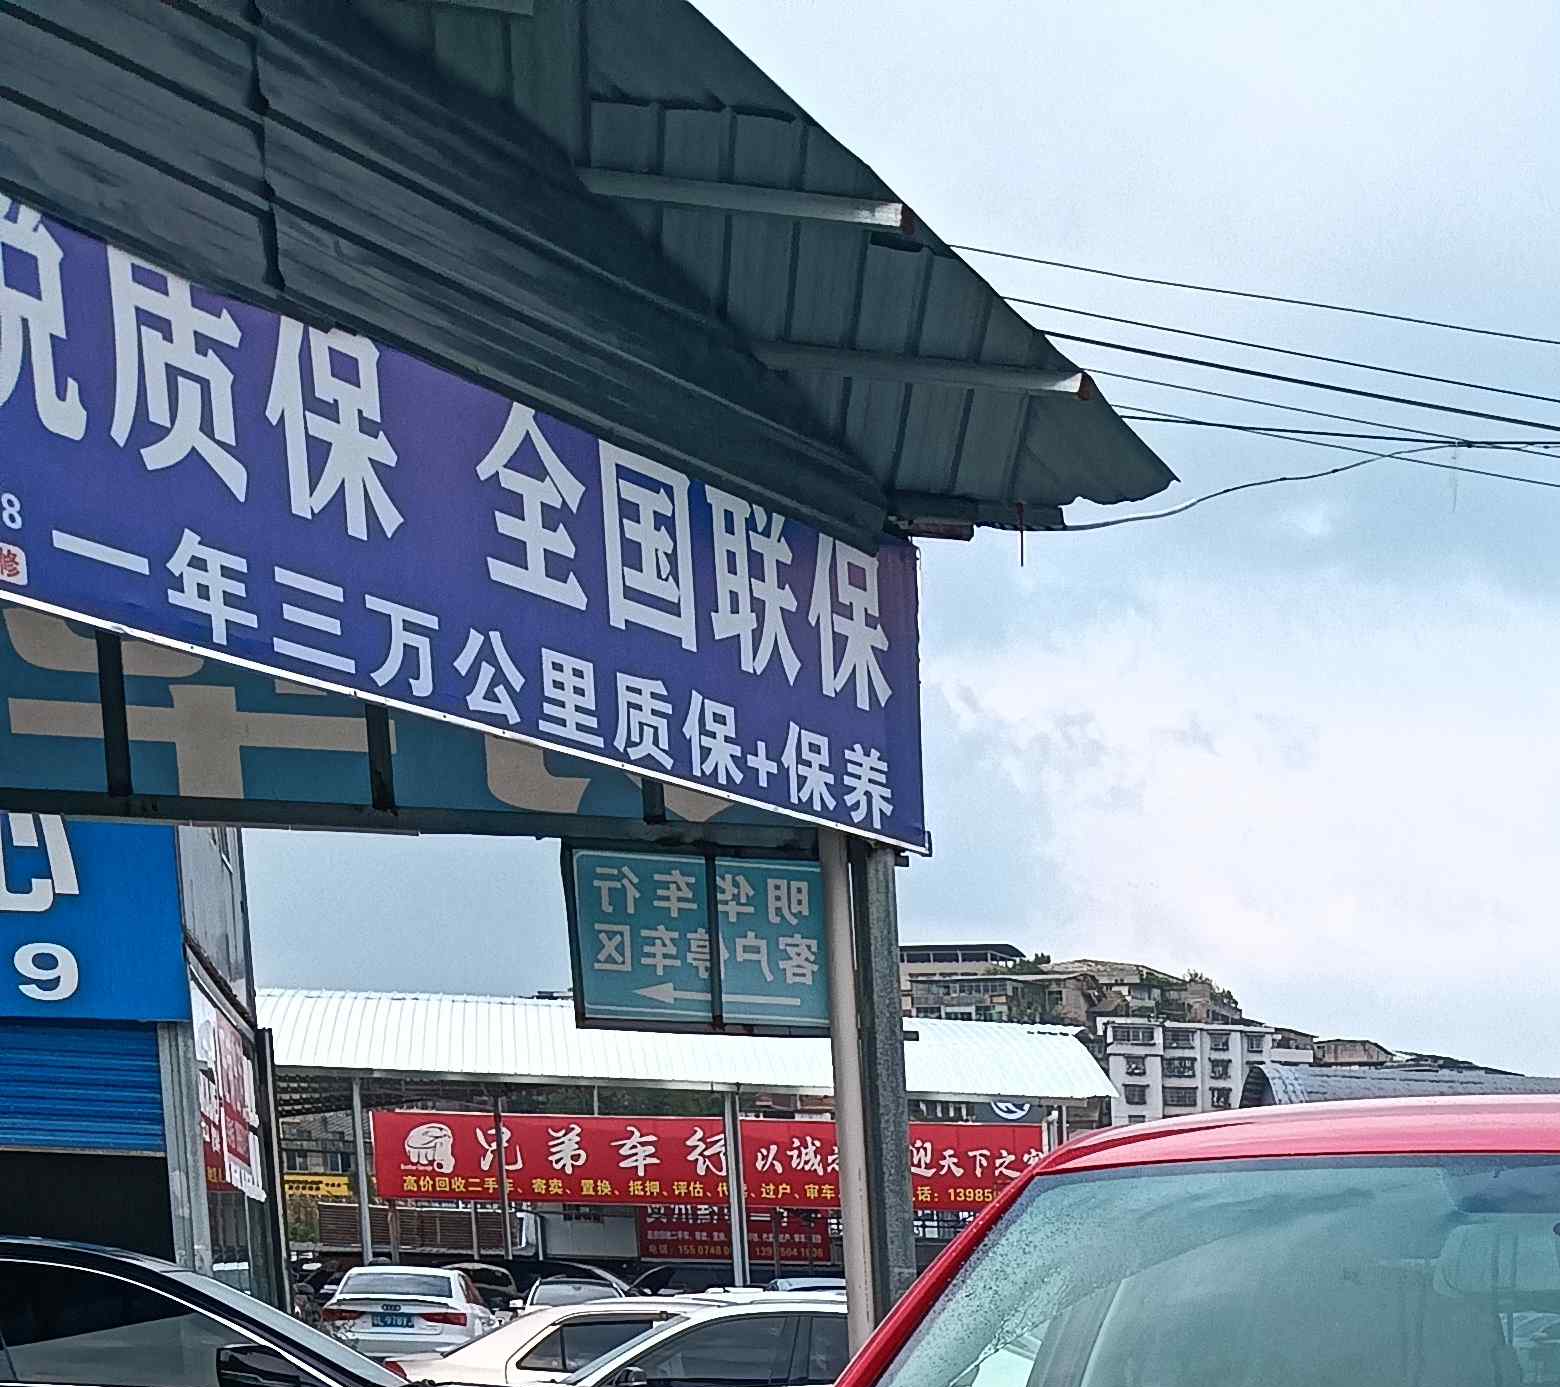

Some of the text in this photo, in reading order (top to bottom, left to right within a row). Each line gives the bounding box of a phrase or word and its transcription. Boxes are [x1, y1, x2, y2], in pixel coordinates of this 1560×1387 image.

[476, 402, 892, 711] 全国联保
[51, 529, 895, 829] 一年三万公里质保+保养
[13, 942, 79, 1001] 9
[475, 1123, 728, 1177] 兄弟车行
